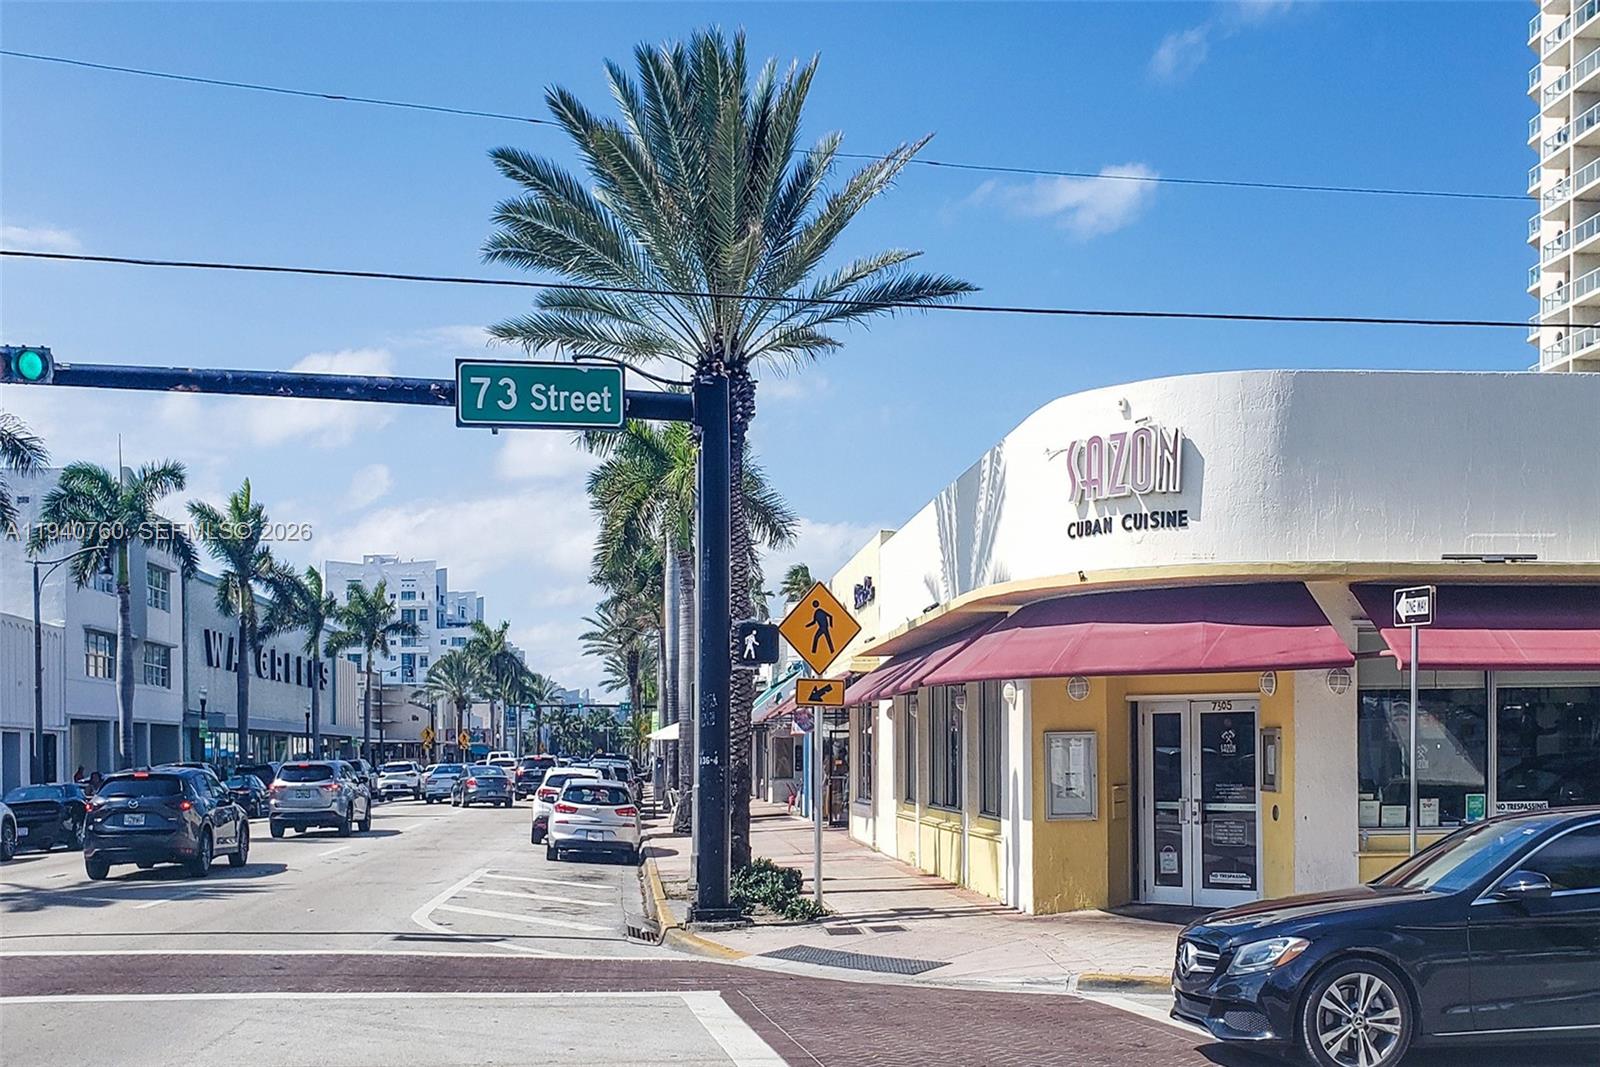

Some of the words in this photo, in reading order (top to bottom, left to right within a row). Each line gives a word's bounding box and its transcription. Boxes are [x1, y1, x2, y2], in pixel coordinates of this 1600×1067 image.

[470, 377, 518, 410] 73
[530, 383, 612, 413] Street
[1067, 516, 1113, 540] CUBAN
[1121, 509, 1189, 532] CUISINE
[1405, 600, 1416, 614] ONE
[1211, 700, 1233, 711] 7305
[1507, 802, 1547, 811] TRESPASSING
